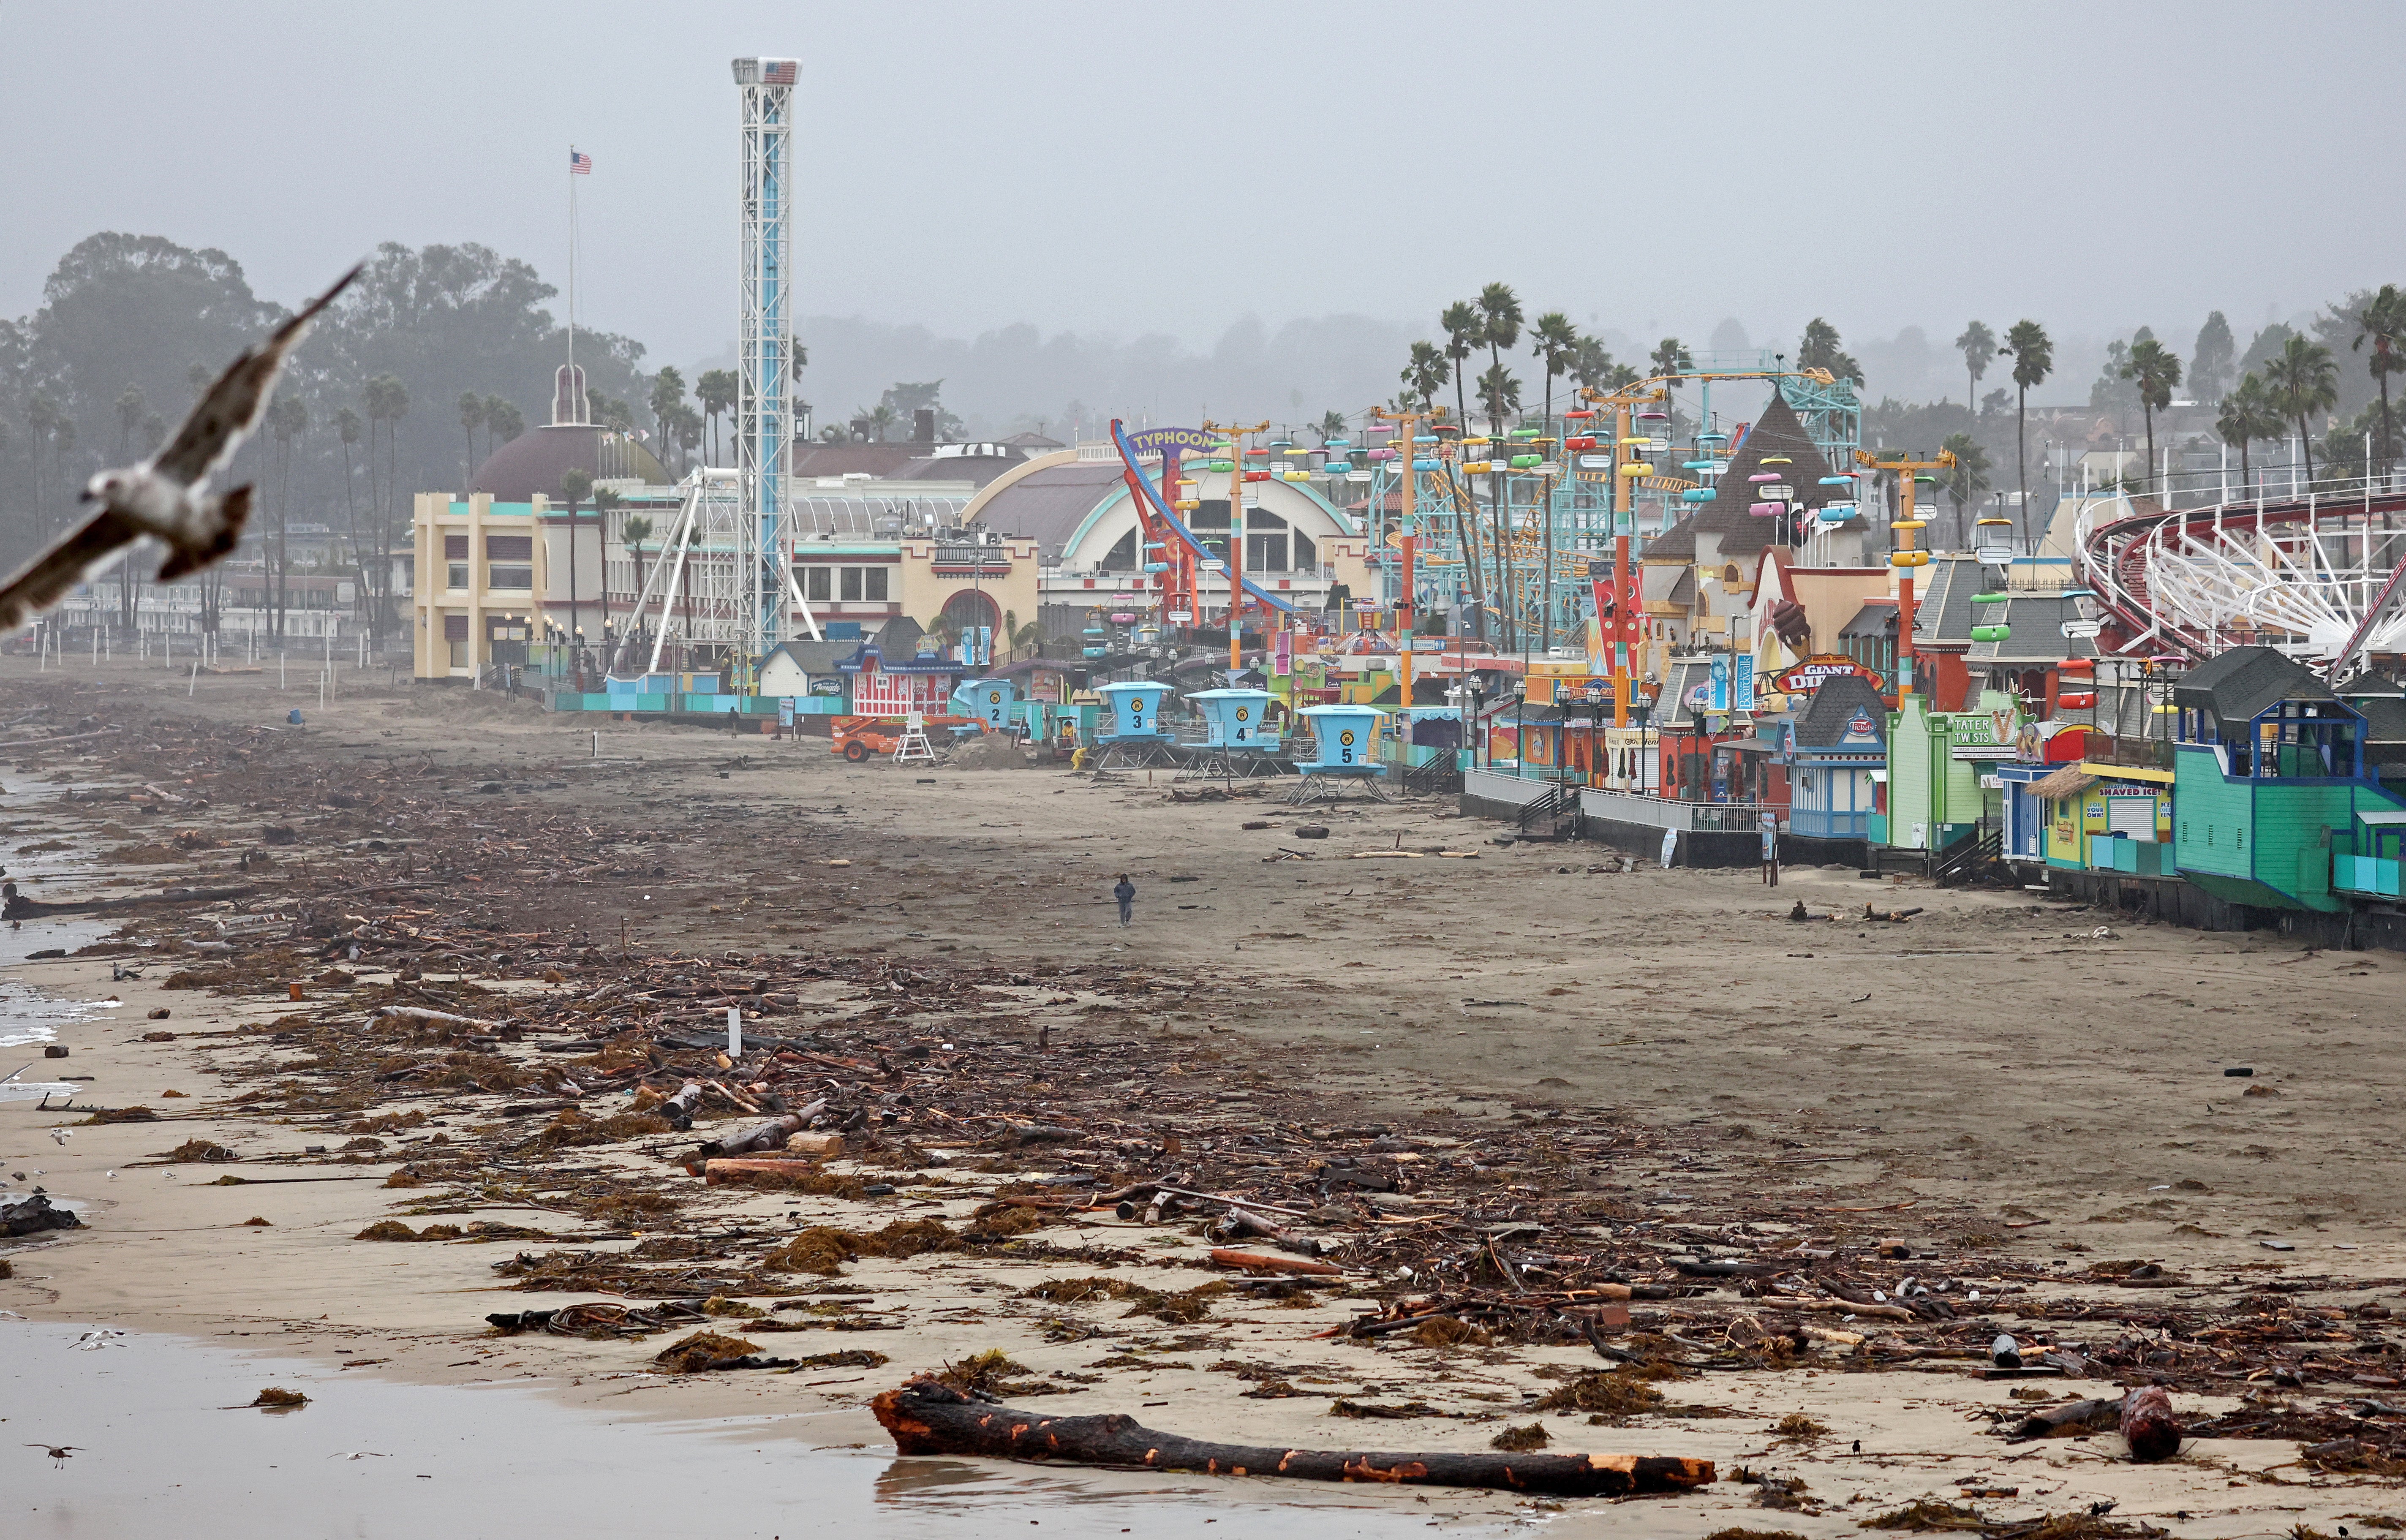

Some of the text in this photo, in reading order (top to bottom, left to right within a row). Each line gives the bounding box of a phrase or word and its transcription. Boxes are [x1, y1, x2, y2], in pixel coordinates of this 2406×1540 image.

[1133, 431, 1215, 449] TYPHOON
[1804, 665, 1854, 675] GIANT
[1739, 657, 1751, 708] Boardwalk
[1788, 675, 1826, 690] DIP
[1600, 688, 1615, 697] CAK
[992, 709, 1000, 721] 2
[1133, 715, 1141, 728] 3
[1849, 721, 1874, 731] Tickets
[1954, 720, 1989, 730] TATER
[1236, 727, 1246, 741] 4
[1342, 748, 1352, 763] 5
